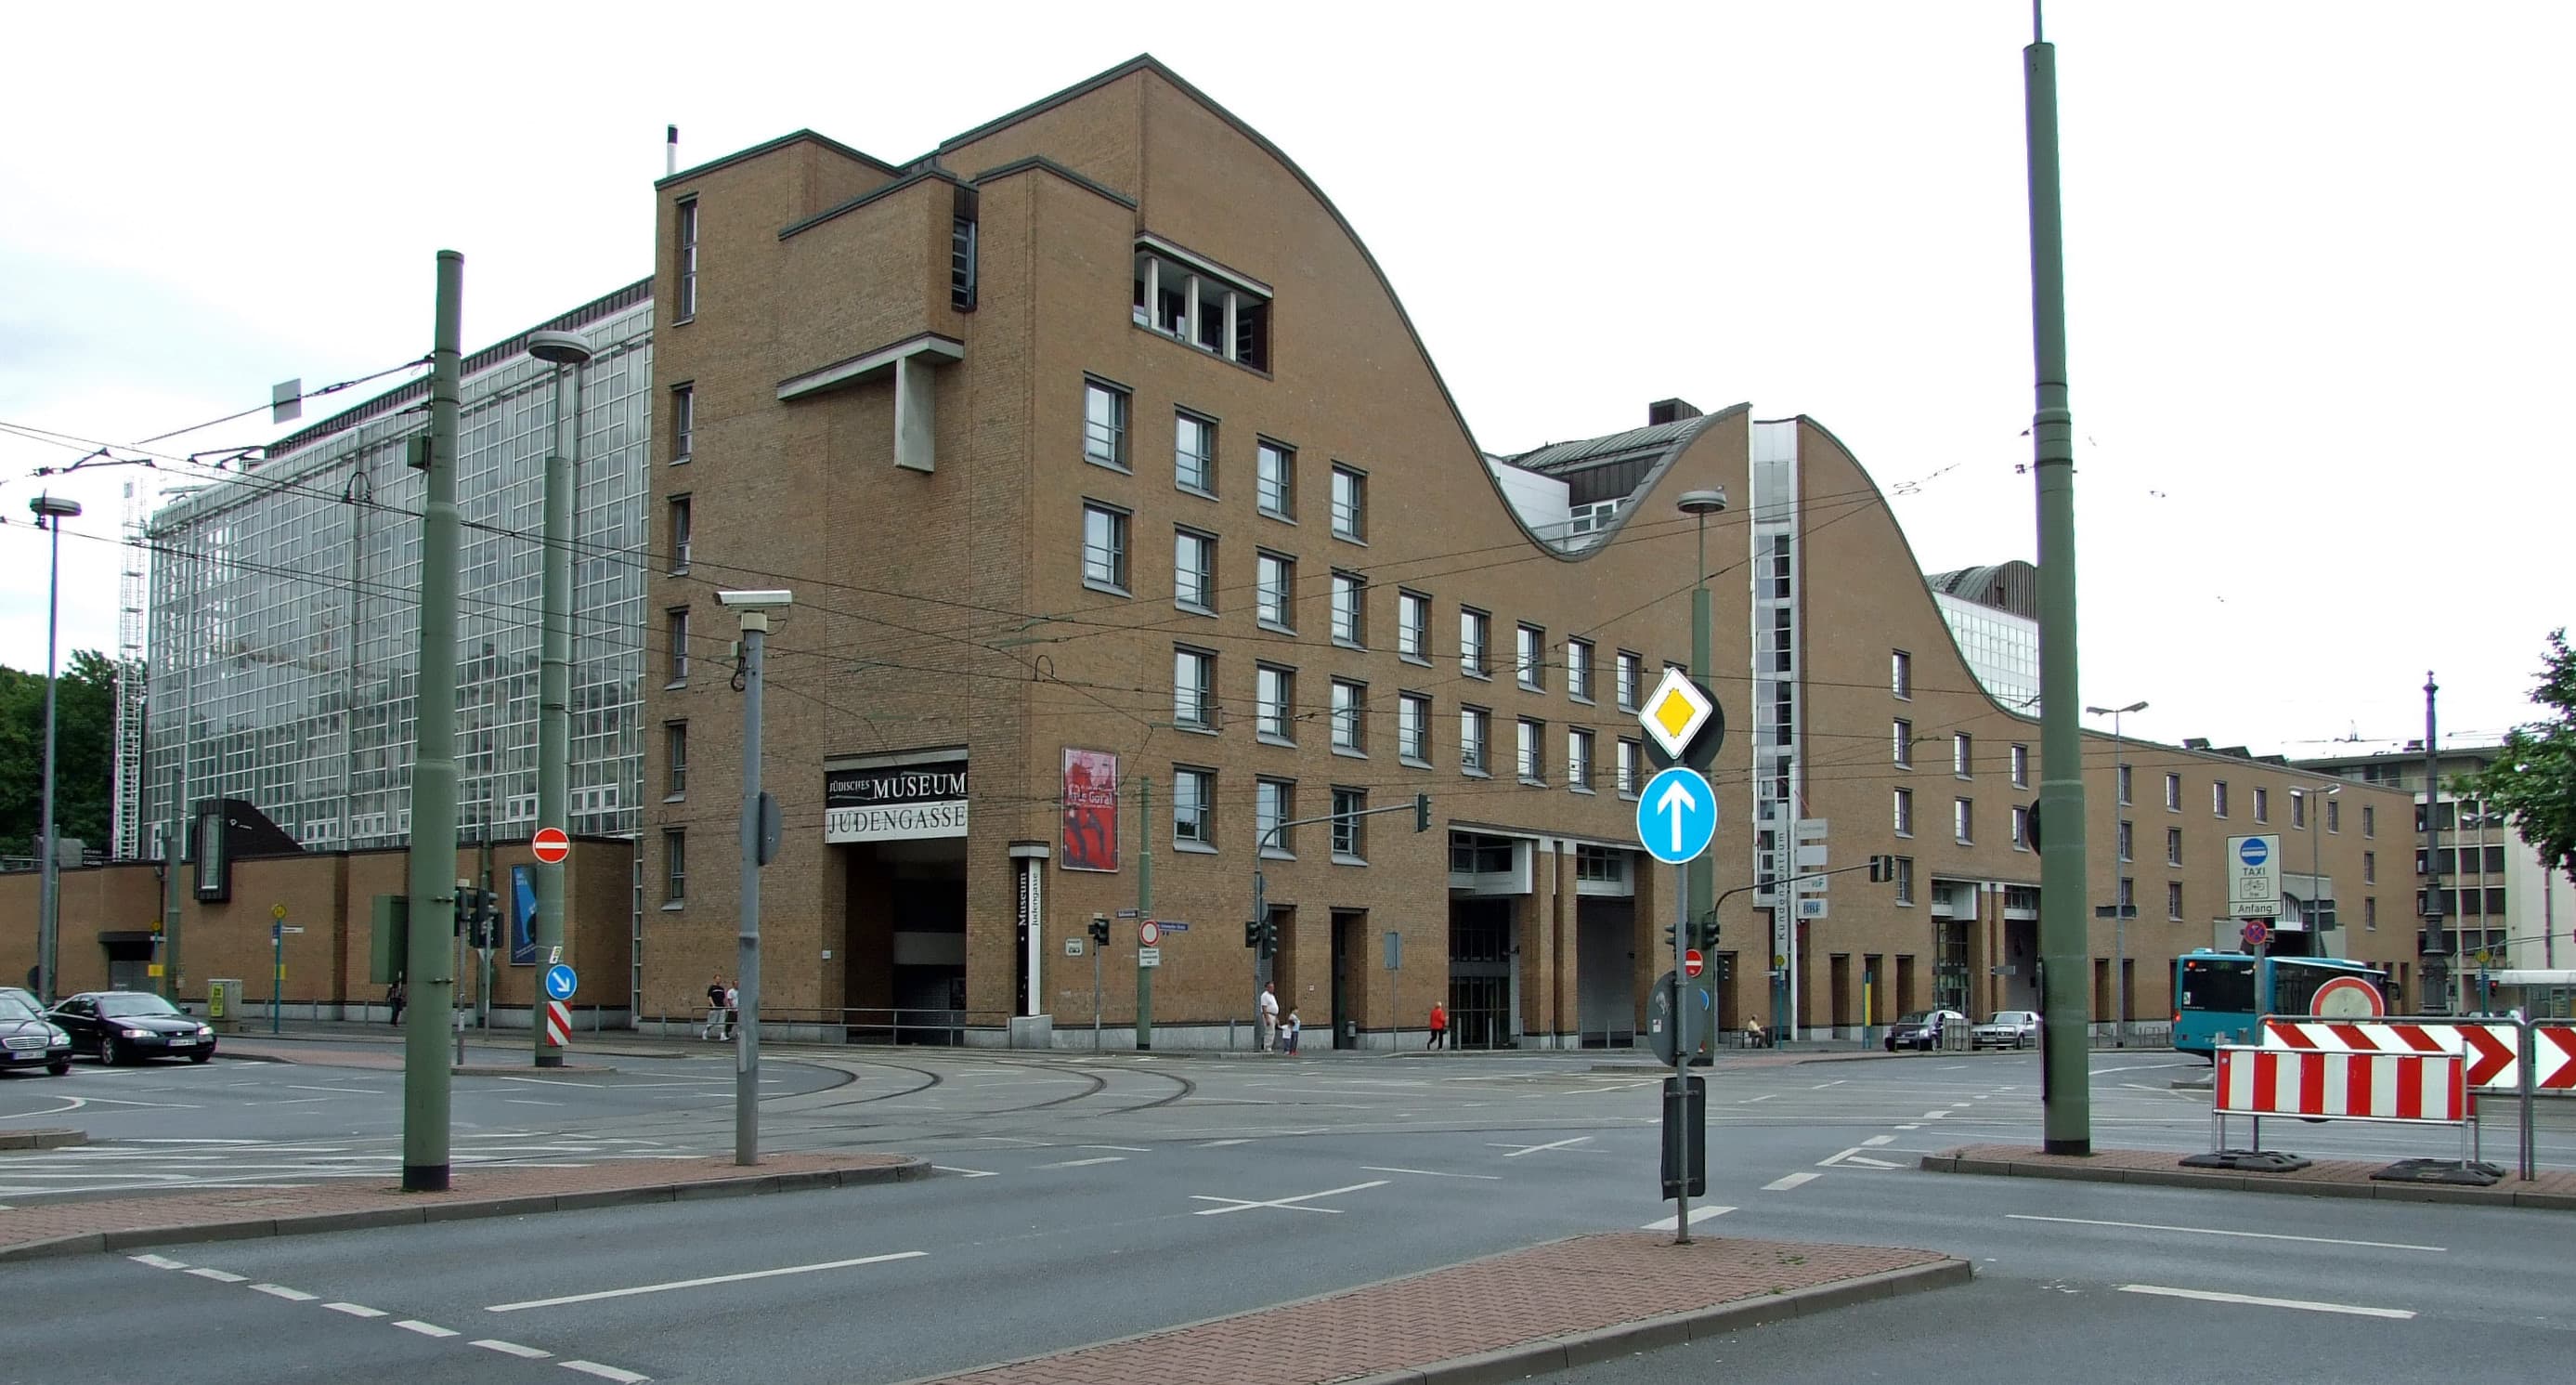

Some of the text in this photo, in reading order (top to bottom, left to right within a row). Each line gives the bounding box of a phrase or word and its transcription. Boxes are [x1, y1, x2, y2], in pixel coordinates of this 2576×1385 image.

[829, 773, 966, 799] JÜDISCHES MUSEUM
[828, 805, 966, 834] JUDENGASSE
[2243, 867, 2266, 876] TAXI
[1019, 871, 1027, 927] Museum
[2238, 904, 2272, 914] Anfang
